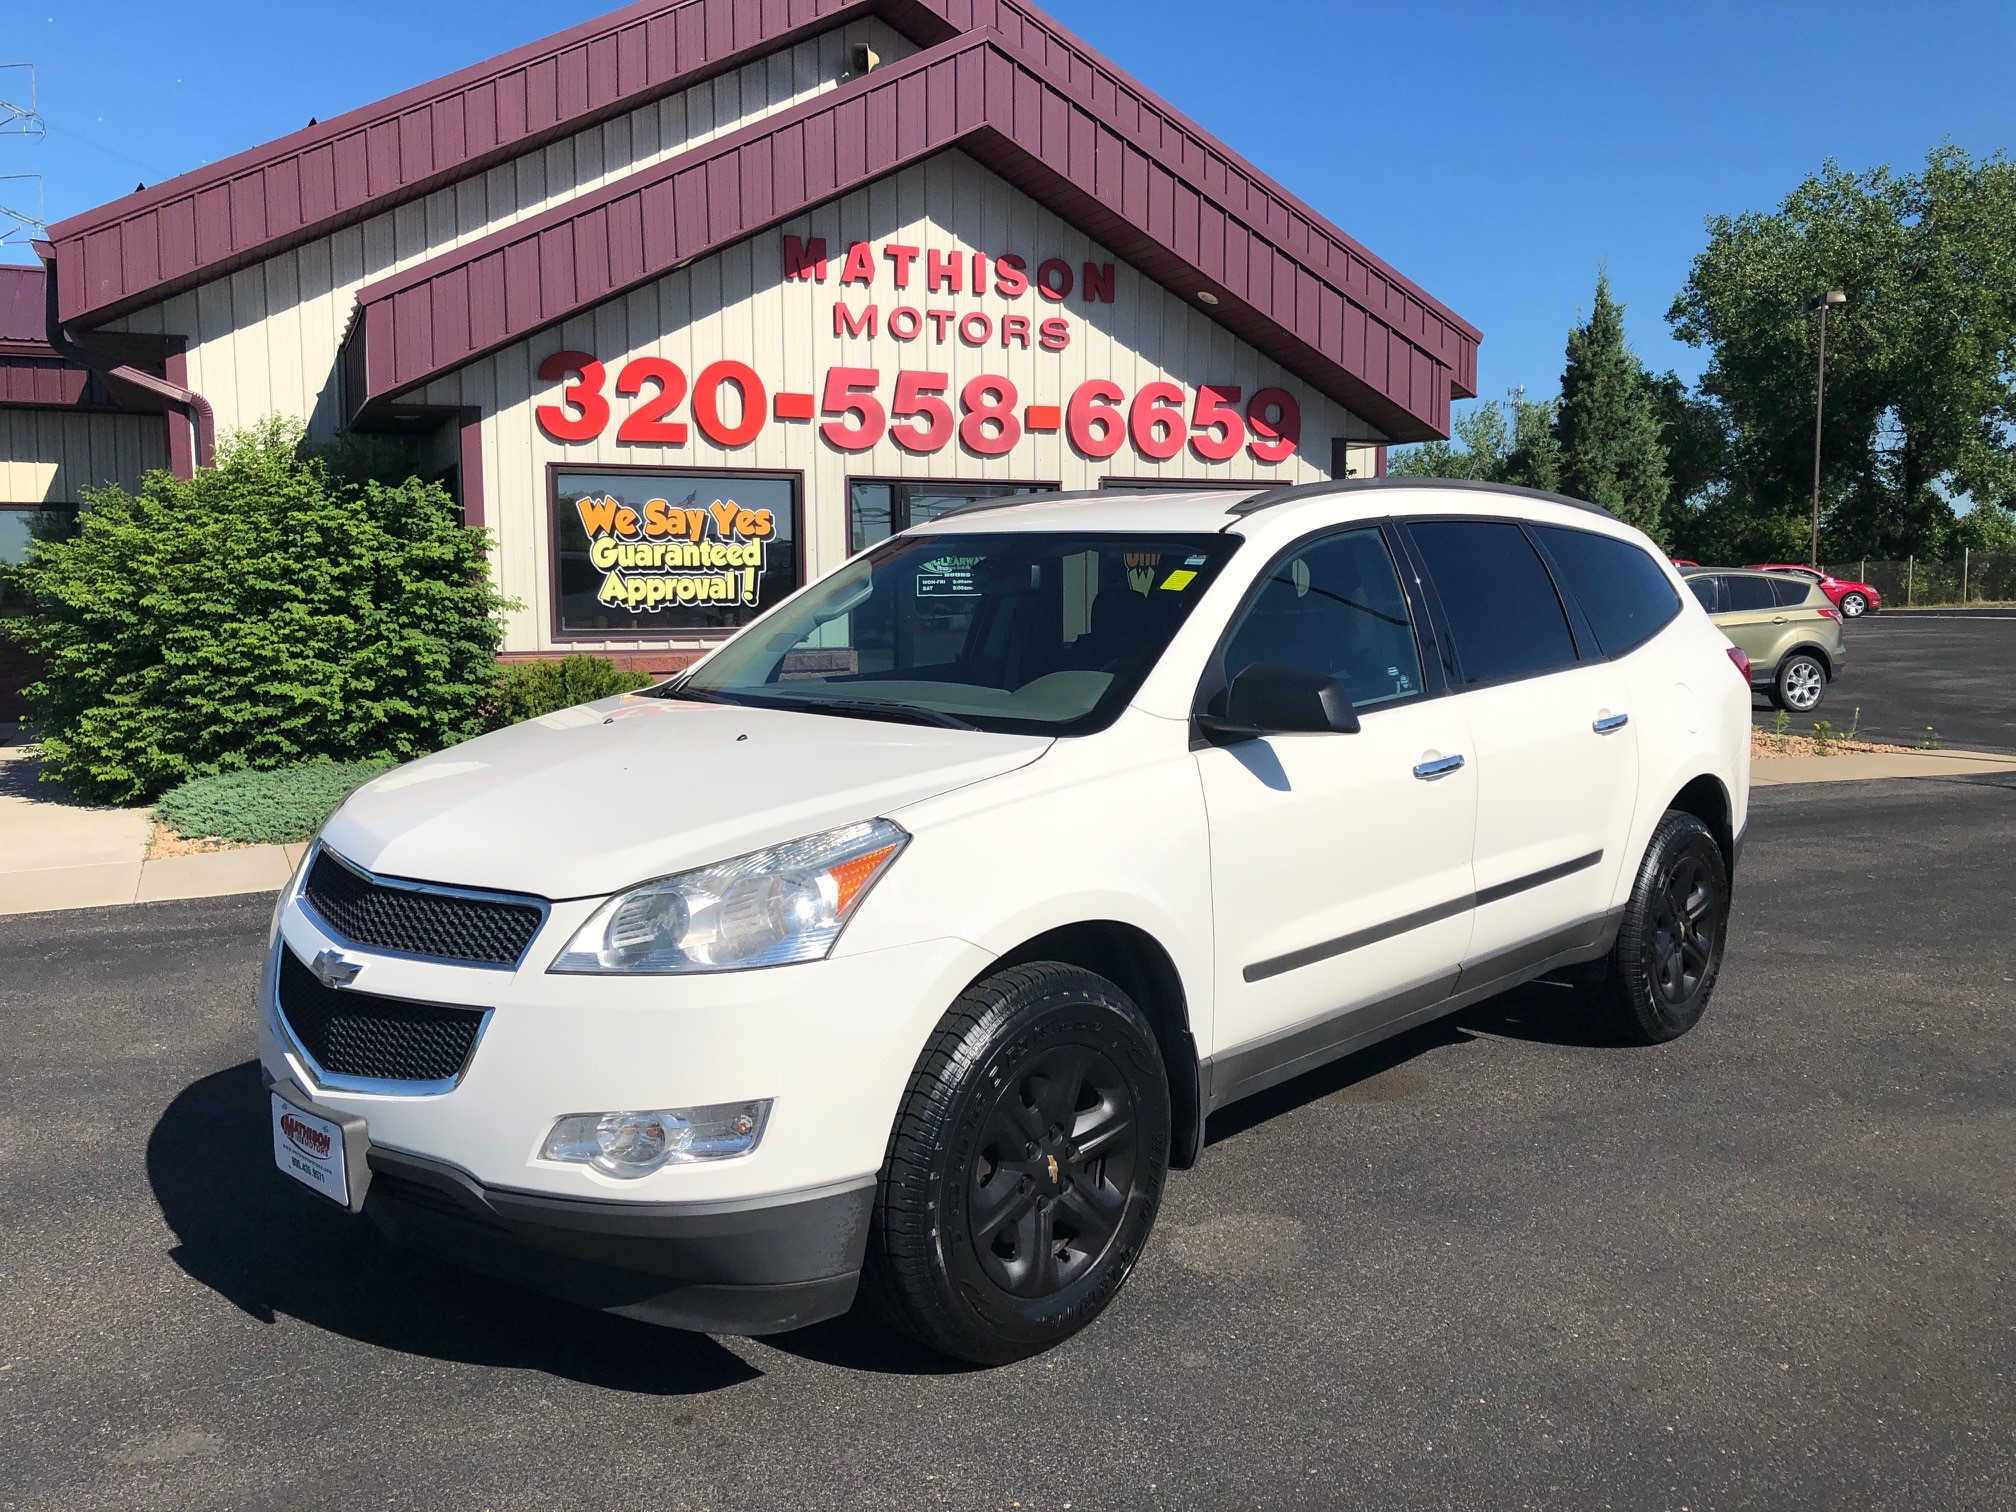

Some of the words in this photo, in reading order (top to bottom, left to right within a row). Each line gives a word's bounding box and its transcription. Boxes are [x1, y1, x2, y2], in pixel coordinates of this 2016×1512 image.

[784, 235, 1115, 304] MATHISON
[833, 302, 1071, 349] MOTORS
[535, 350, 1300, 462] 320-558-6659
[577, 495, 640, 538] We
[644, 499, 708, 542] Say
[709, 499, 773, 537] Yes
[591, 537, 763, 569] Guaranteed
